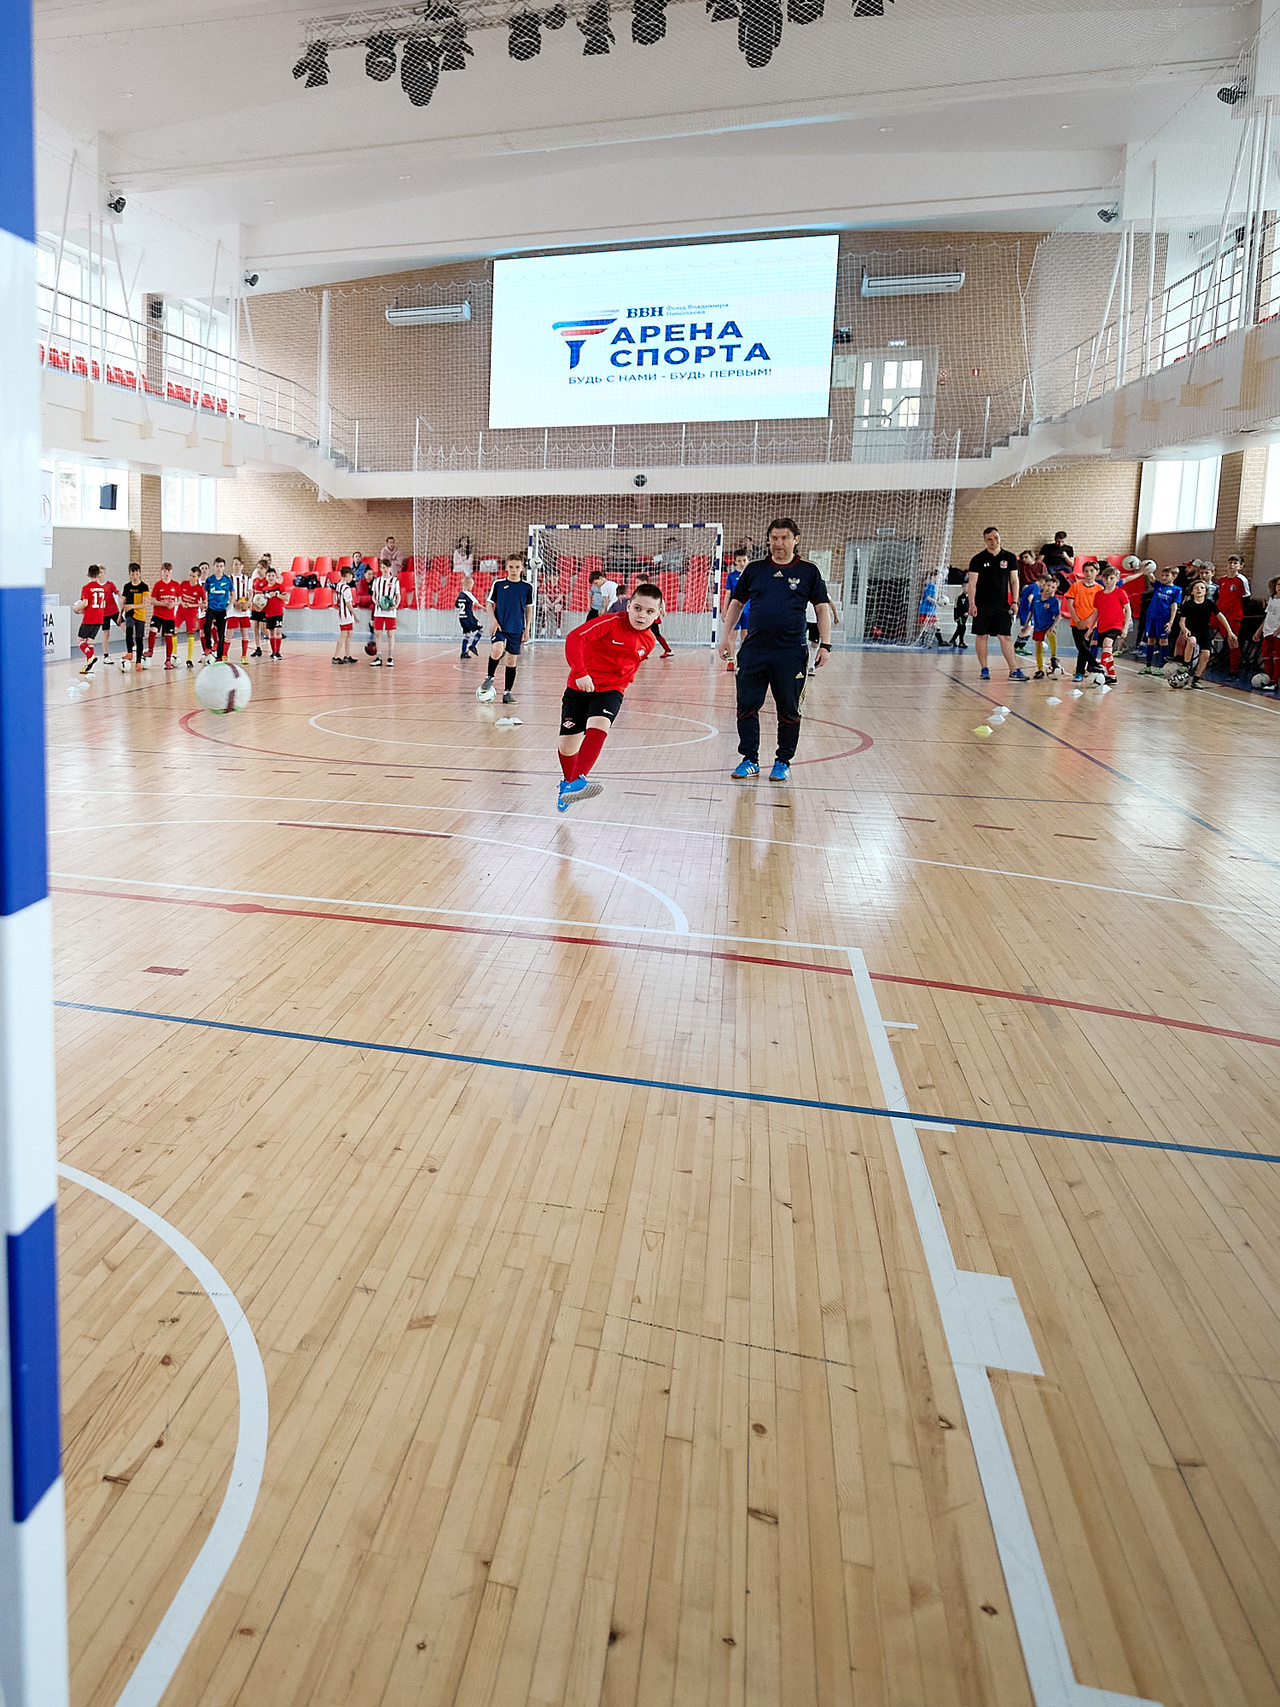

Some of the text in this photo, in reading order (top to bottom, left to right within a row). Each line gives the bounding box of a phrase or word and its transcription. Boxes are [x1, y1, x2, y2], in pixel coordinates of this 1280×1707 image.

[626, 306, 664, 319] ВВН
[610, 320, 744, 346] АРЕНА
[609, 343, 771, 368] СПОРТА
[568, 376, 602, 385] БУДЬ
[606, 375, 615, 383] С
[619, 373, 657, 382] НАМИ
[670, 371, 706, 381] БУДЬ
[709, 368, 772, 378] ПЕРВЫМ!
